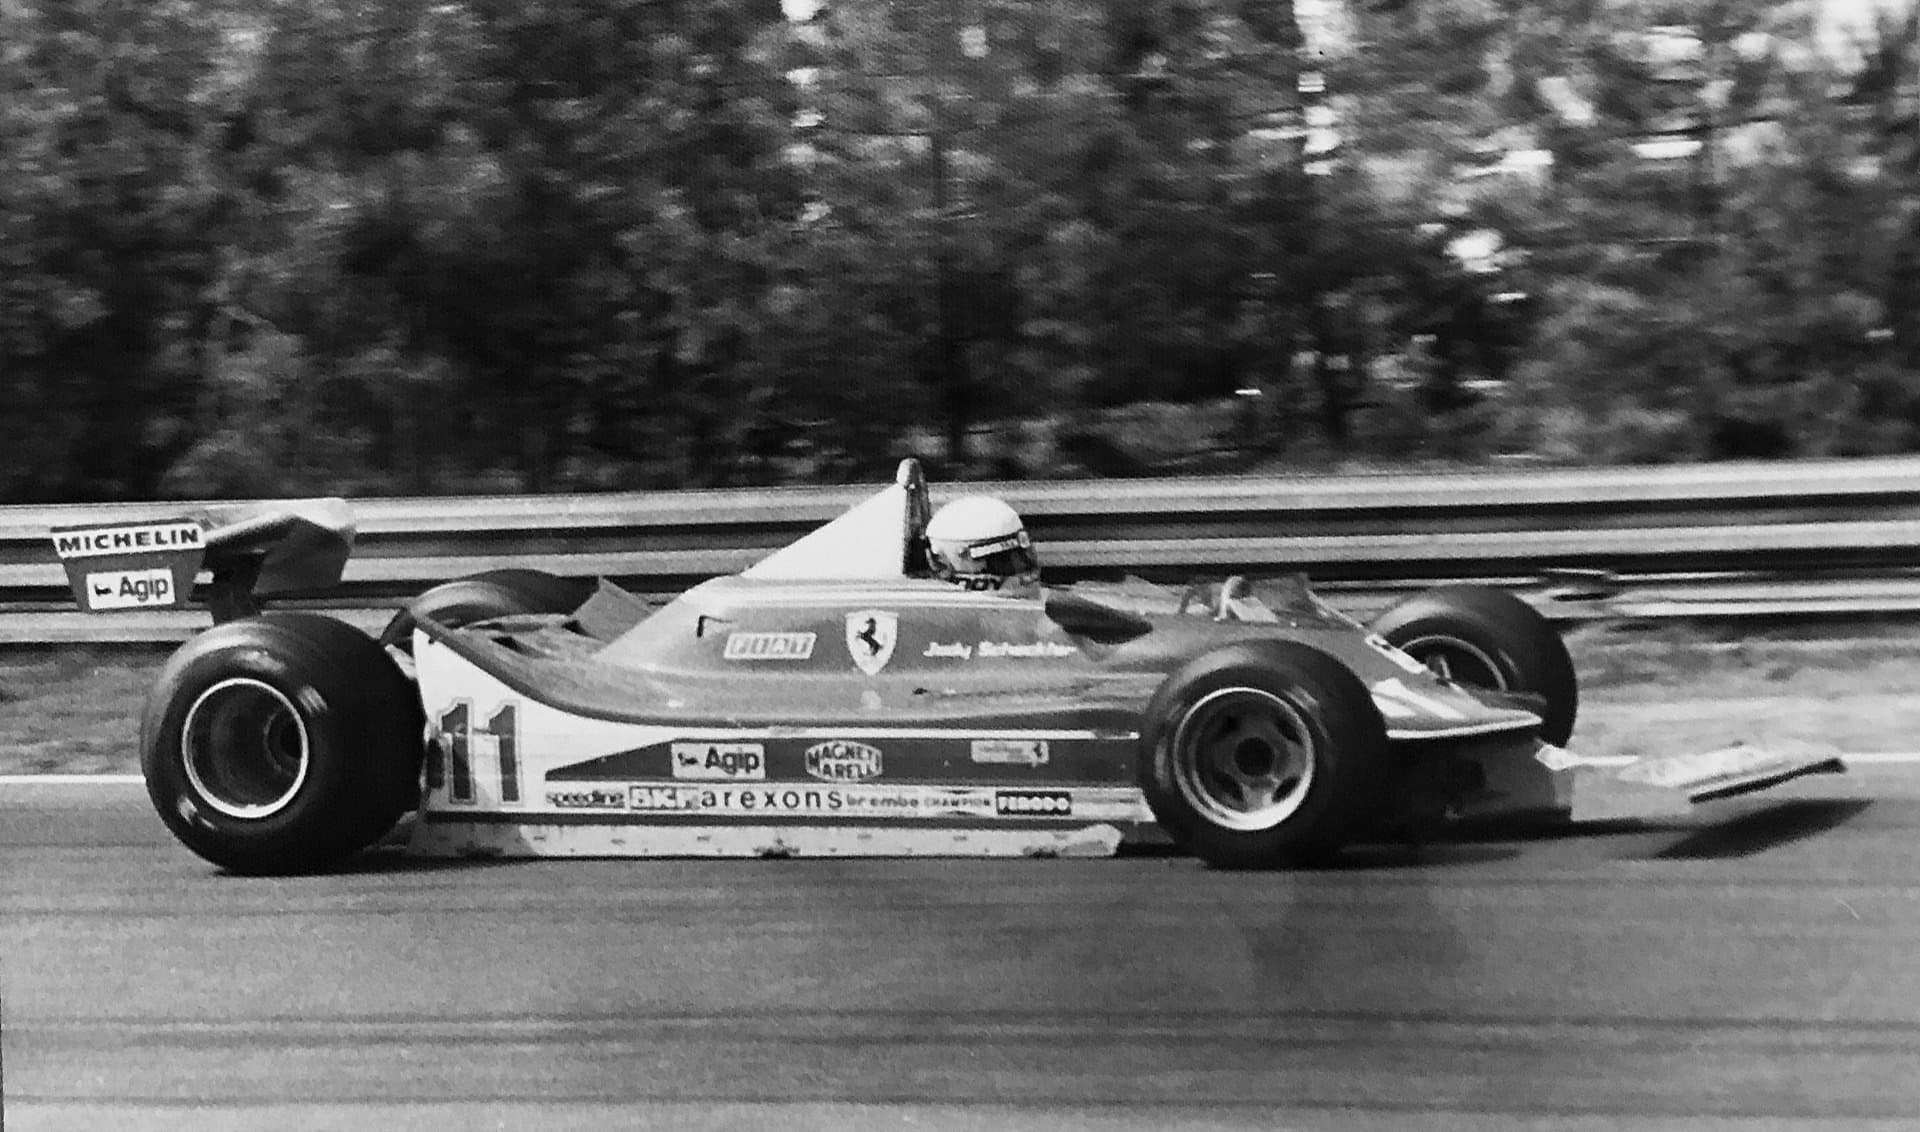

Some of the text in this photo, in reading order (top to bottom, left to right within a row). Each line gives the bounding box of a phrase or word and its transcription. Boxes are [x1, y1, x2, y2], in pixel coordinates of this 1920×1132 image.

[58, 527, 199, 552] MICHELIN
[118, 576, 169, 602] Agip
[438, 700, 523, 804] 11
[704, 746, 760, 775] Agip
[701, 789, 843, 810] arexons
[846, 794, 919, 808] brembo
